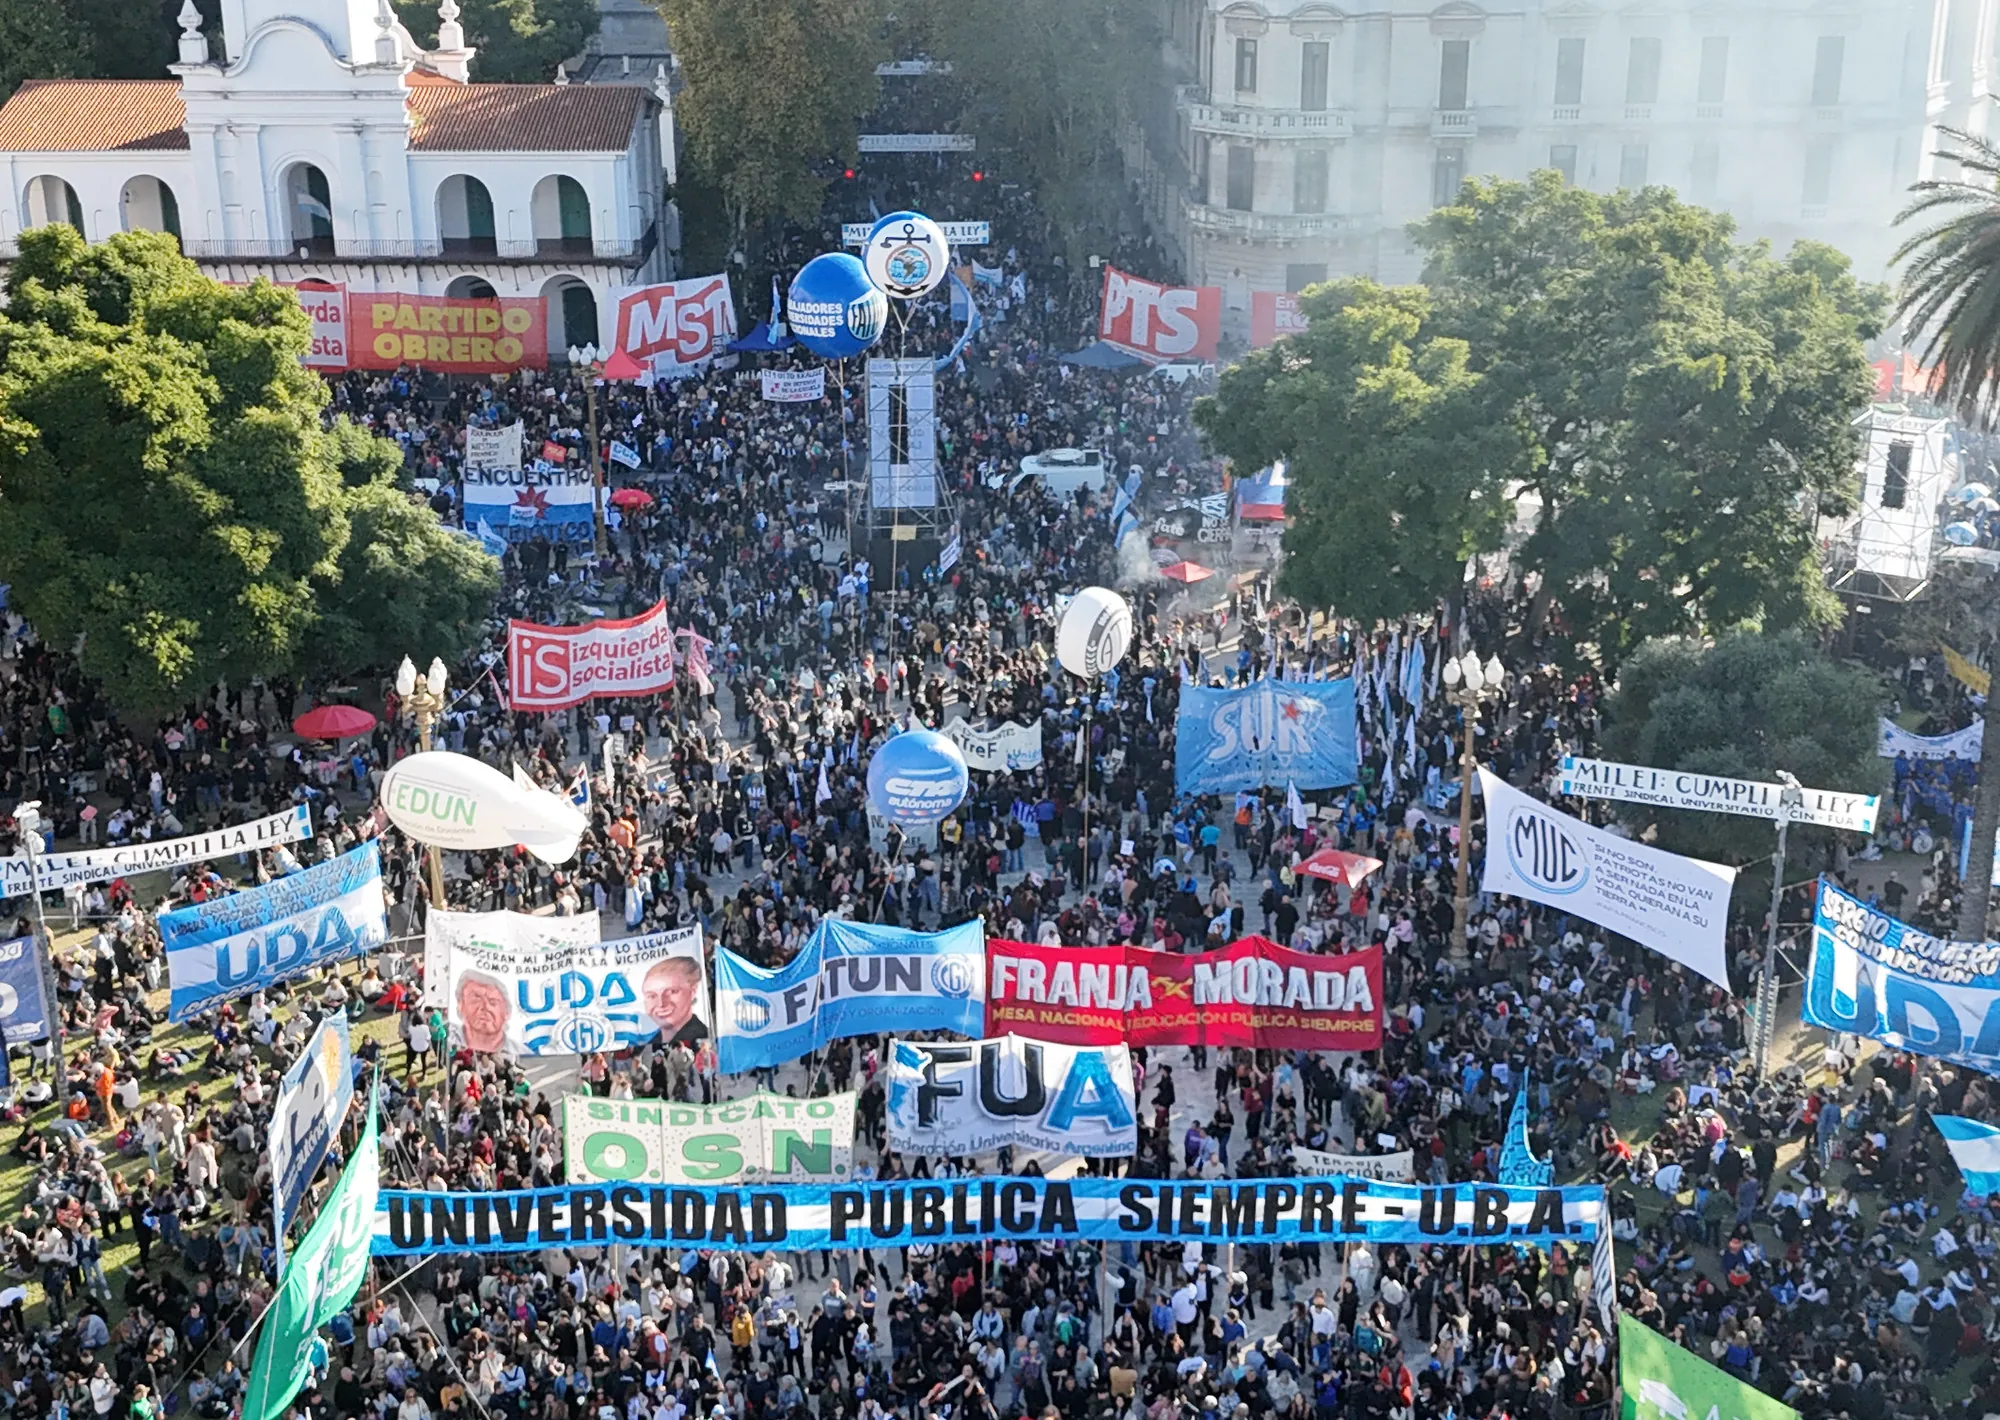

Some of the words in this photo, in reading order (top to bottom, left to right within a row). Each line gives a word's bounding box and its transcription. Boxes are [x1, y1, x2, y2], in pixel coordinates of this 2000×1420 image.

[961, 225, 979, 237] LEY
[372, 303, 532, 334] PARTIDO
[1103, 271, 1199, 354] PTS
[373, 332, 524, 364] OBRERO
[464, 467, 591, 487] ENCUENTRO
[572, 625, 669, 664] izquierda
[521, 638, 568, 695] iS
[572, 652, 671, 688] socialista
[1207, 690, 1318, 760] SUR
[396, 783, 477, 826] EDUN
[888, 796, 953, 809] autónoma
[1573, 781, 1616, 797] FRENTE
[1624, 789, 1675, 804] SINDICAL
[1681, 797, 1774, 816] UNIVERSITARIO
[1789, 808, 1814, 822] CIN
[1827, 813, 1854, 827] FUA
[1675, 775, 1768, 806] CUMPLI
[1816, 791, 1858, 814] LEY
[222, 830, 245, 850] LA
[258, 813, 294, 840] LEY
[1515, 814, 1578, 883] MUC
[63, 865, 118, 885] SINDICAL
[1595, 854, 1665, 887] PATRIOTAS
[1668, 880, 1686, 893] NO
[1688, 886, 1713, 901] VAN
[1595, 885, 1637, 910] TIERRA
[1628, 890, 1680, 918] QUIERAN
[1693, 915, 1708, 928] SU
[1631, 880, 1666, 899] NADA
[1684, 899, 1700, 911] LA
[1821, 885, 1890, 941] SERGIO
[215, 903, 356, 989] UDA
[476, 959, 510, 975] COMO
[515, 958, 573, 975] BANDERA
[579, 958, 588, 968] A
[592, 957, 608, 968] LA
[615, 947, 670, 965] VICTORIA
[523, 954, 537, 964] MI
[601, 947, 608, 956] Y
[615, 942, 629, 955] LO
[637, 929, 694, 952] LLEVARAN
[517, 970, 637, 1014] UDA
[991, 954, 1153, 1012] FRANJA
[1193, 955, 1375, 1013] MORADA
[993, 1006, 1036, 1023] MESA
[1039, 1010, 1126, 1032] NACIONAL
[1300, 1018, 1376, 1033] SIEMPRE
[917, 1042, 1135, 1132] FUA
[587, 1101, 836, 1126] SINDICATO
[388, 1187, 788, 1249] UNIVERSIDAD
[830, 1181, 1079, 1242] PUBLICA
[1118, 1182, 1369, 1237] SIEMPRE
